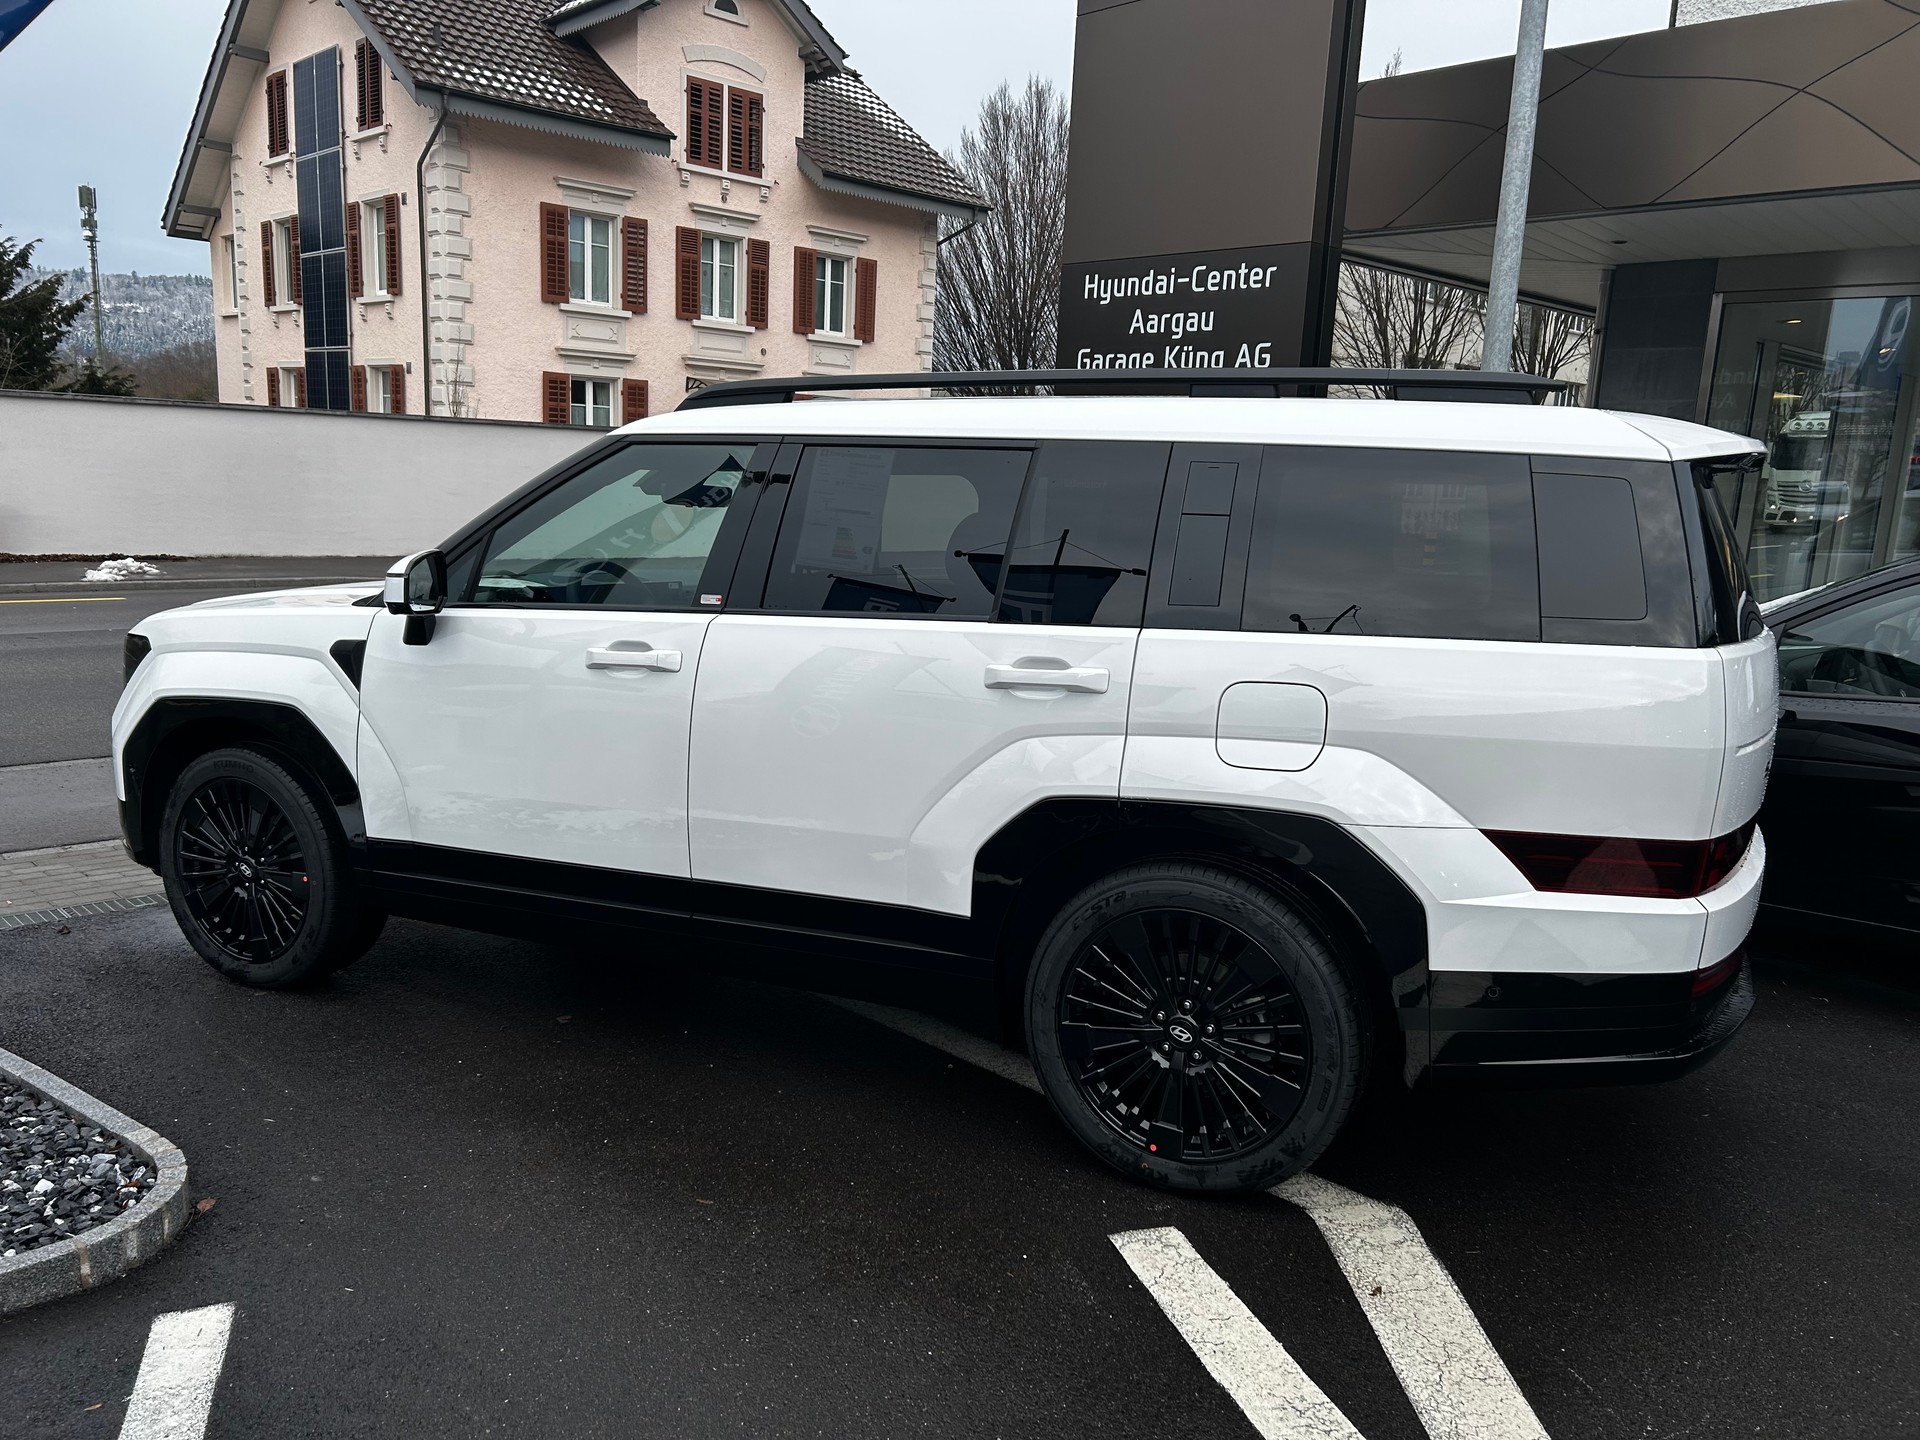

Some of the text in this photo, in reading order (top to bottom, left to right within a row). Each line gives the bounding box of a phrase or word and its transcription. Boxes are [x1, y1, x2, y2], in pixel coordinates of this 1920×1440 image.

[1083, 262, 1278, 304] Hyundai-Center
[1129, 308, 1215, 339] Aargau
[1234, 342, 1272, 368] AG
[213, 760, 254, 773] KUMHO
